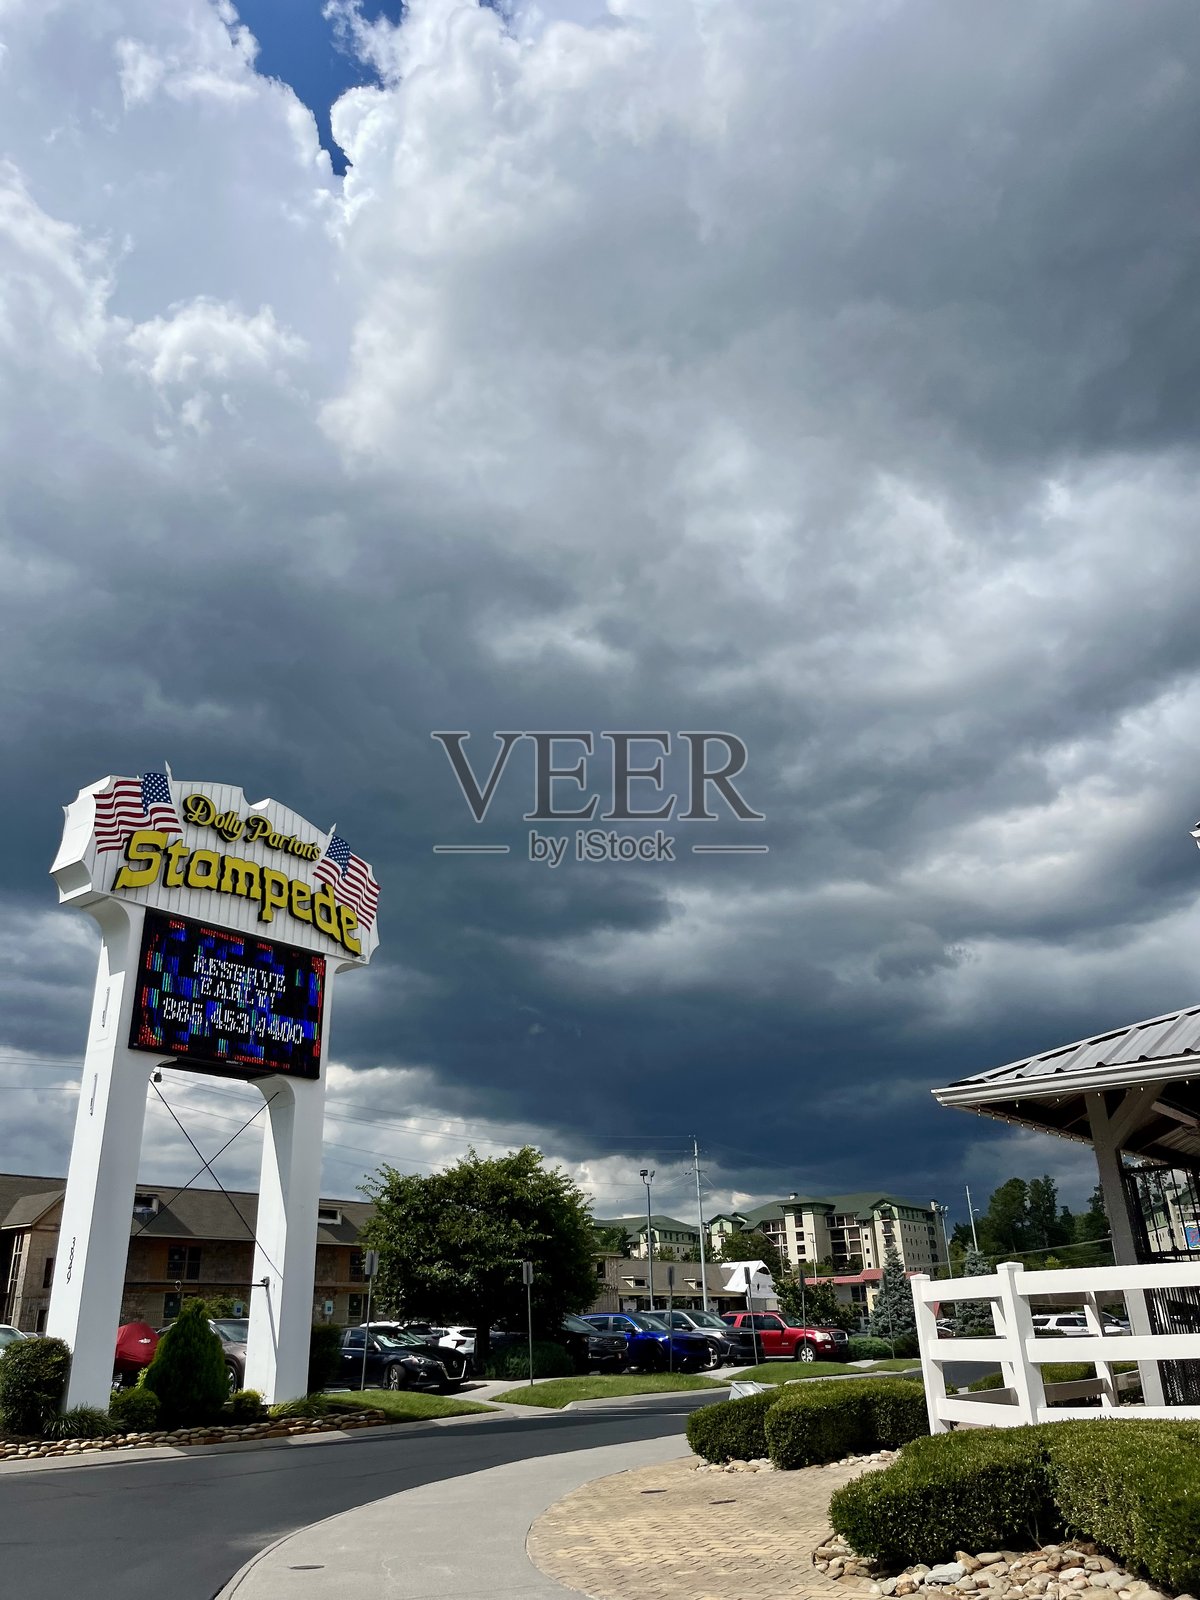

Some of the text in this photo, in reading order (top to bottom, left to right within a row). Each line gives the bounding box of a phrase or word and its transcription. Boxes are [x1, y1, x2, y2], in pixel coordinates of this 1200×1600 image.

[183, 794, 322, 861] Dolly Parton's
[111, 830, 362, 957] Stampede
